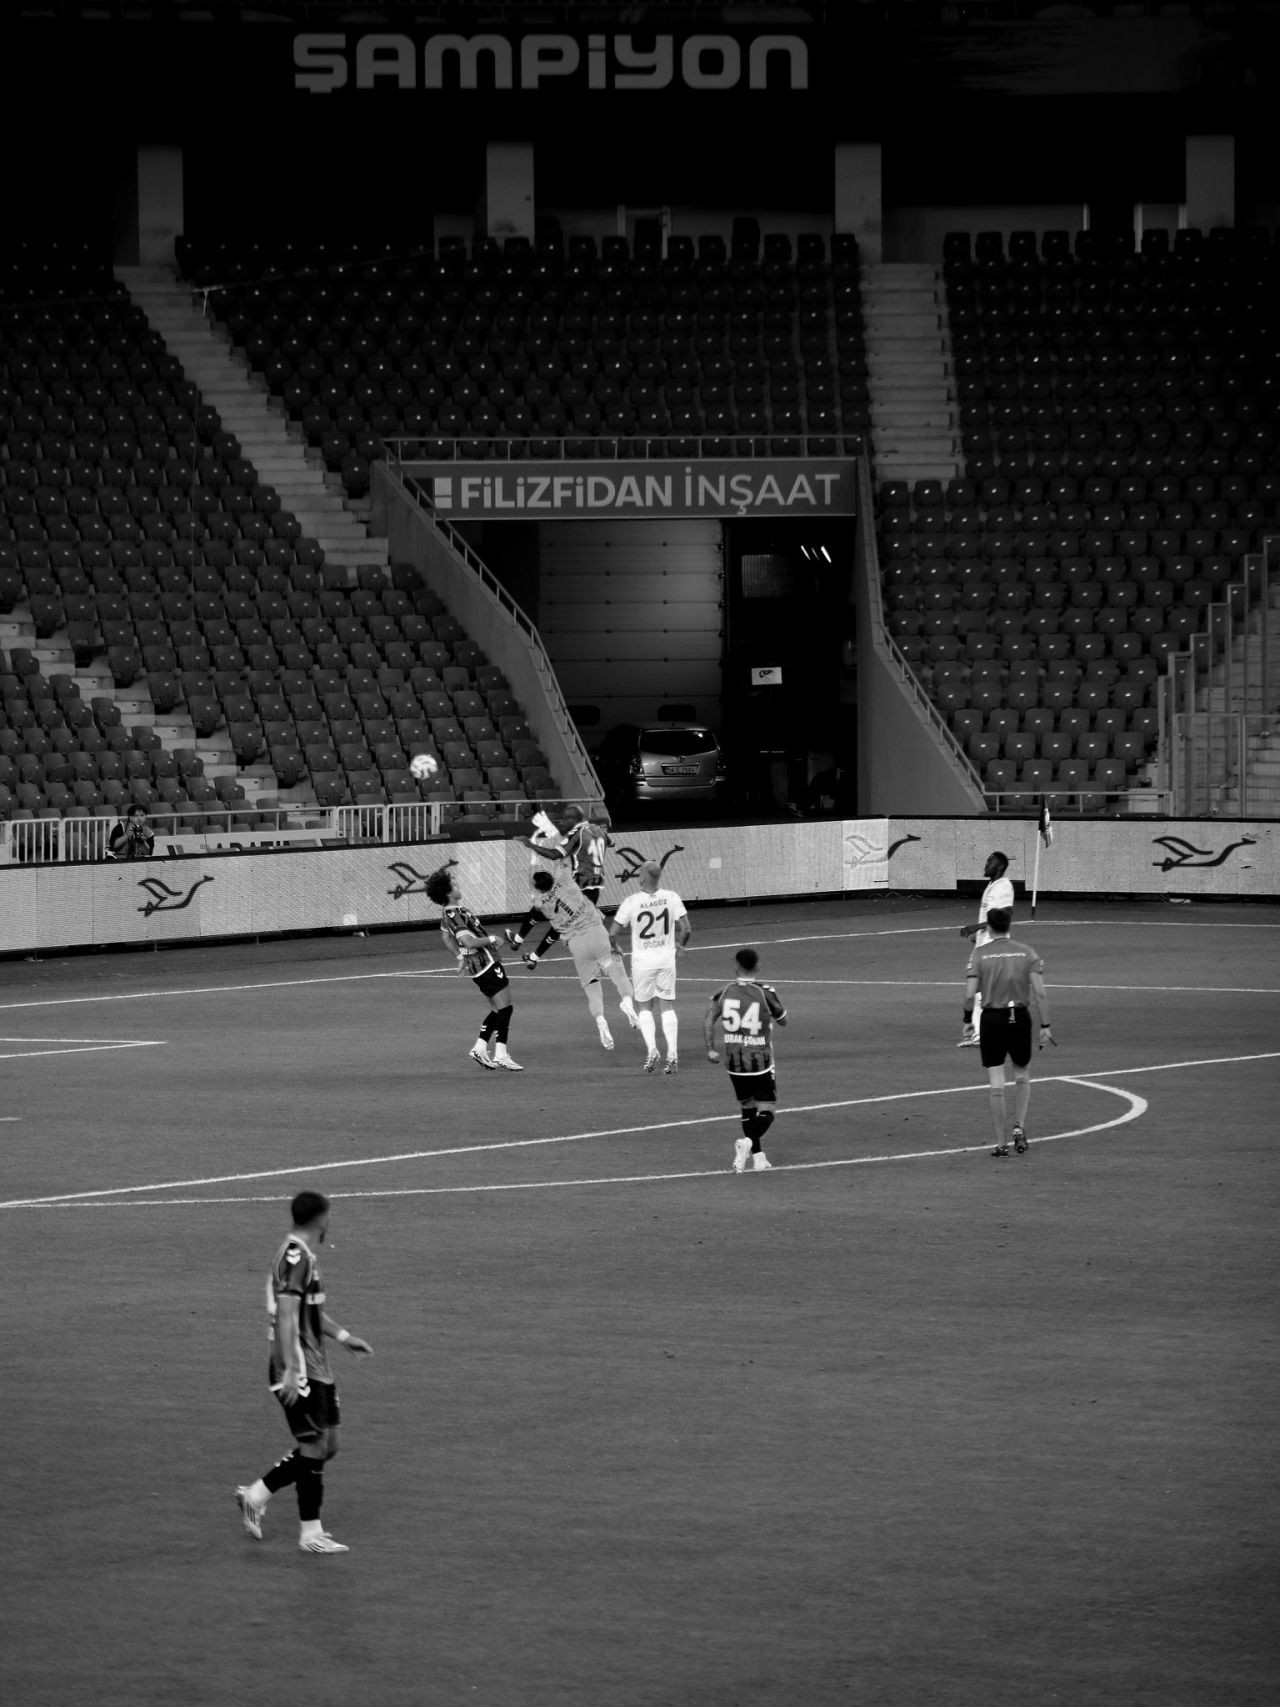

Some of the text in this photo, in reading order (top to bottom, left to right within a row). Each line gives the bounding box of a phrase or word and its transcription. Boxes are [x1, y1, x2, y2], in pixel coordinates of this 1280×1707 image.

[684, 466, 841, 515] İNŞAAT
[637, 908, 670, 939] 21
[722, 998, 763, 1035] 54
